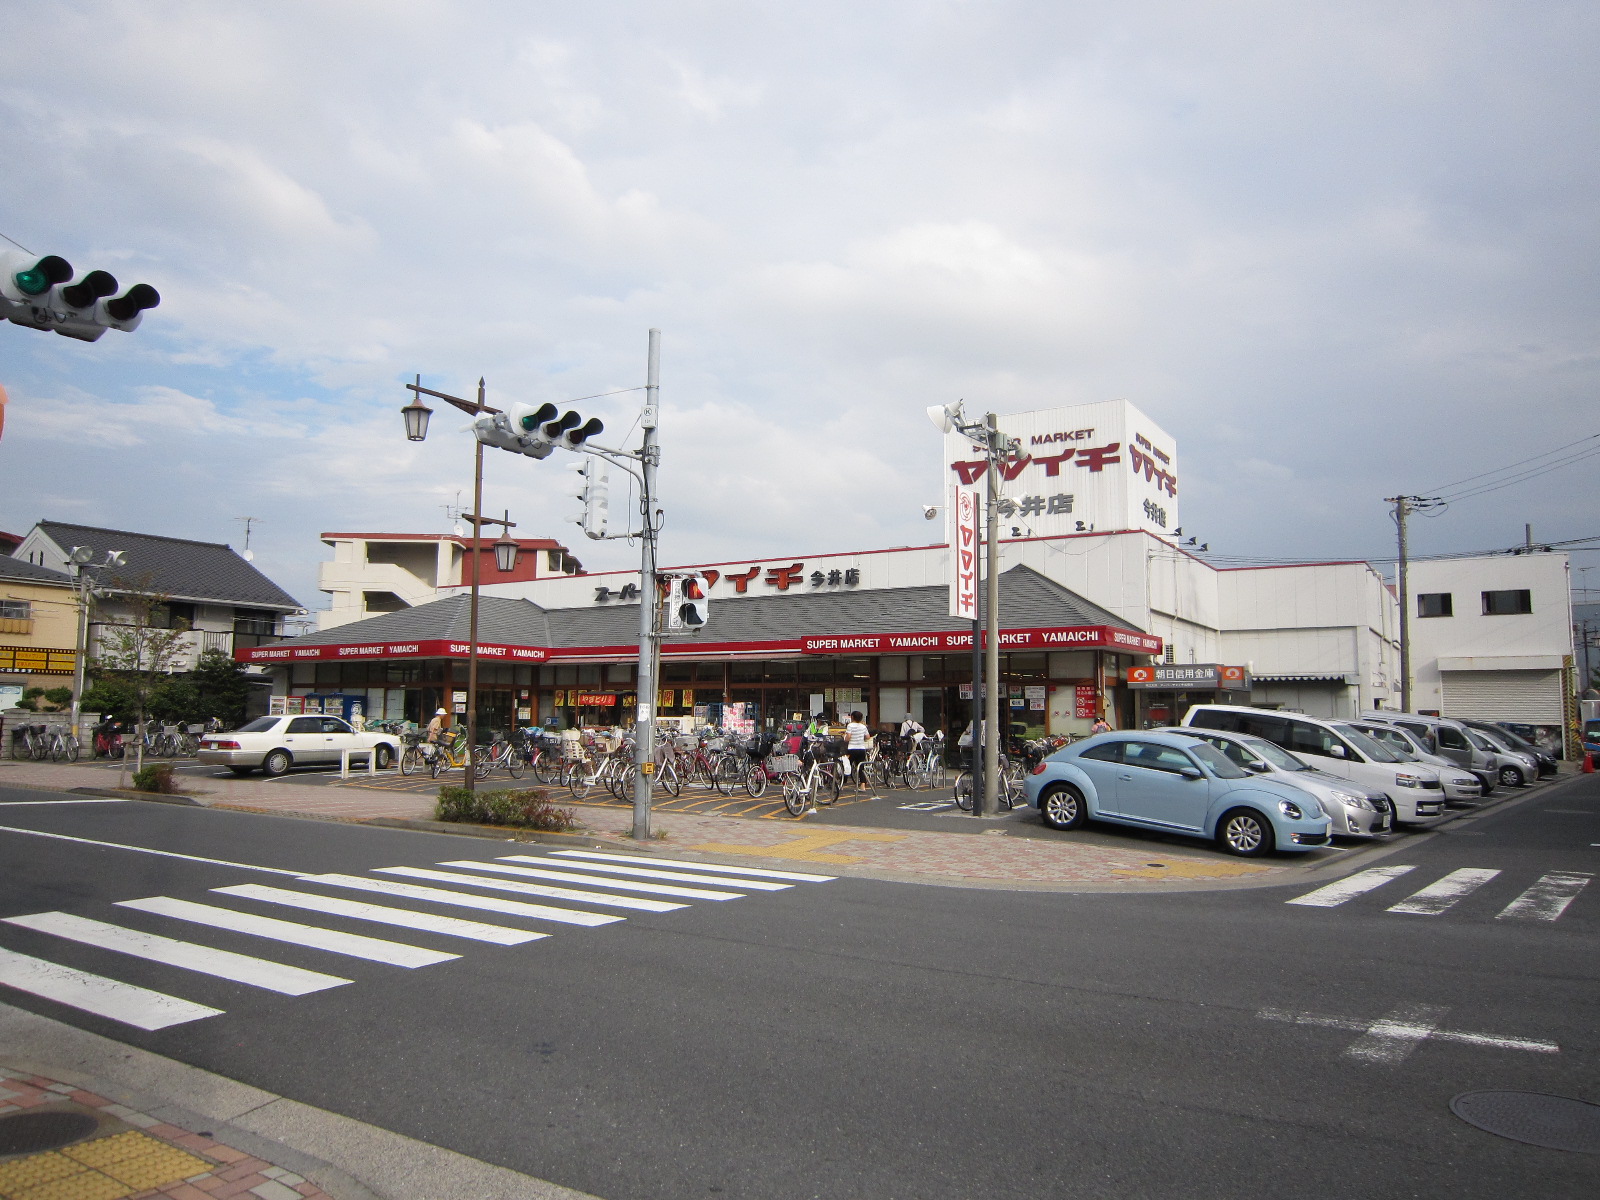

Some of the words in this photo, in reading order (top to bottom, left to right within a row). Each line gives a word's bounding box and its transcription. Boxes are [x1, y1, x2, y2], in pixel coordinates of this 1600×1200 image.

[1031, 428, 1095, 446] MARKET
[951, 443, 1120, 485] ヤマイチ
[1129, 444, 1176, 498] ヤマイチ
[1143, 498, 1166, 528] 今井店
[811, 568, 860, 587] 今井店
[959, 525, 974, 612] ヤマイチ
[807, 639, 837, 649] SUPER
[840, 638, 880, 648] MARKET
[889, 636, 938, 647] YAMAICHI
[946, 635, 973, 645] SUPE
[1042, 631, 1098, 642] YAMAICHI
[1114, 632, 1127, 644] SUPER
[1127, 635, 1140, 646] MARKET
[251, 651, 269, 659] SUPER
[269, 650, 290, 658] MARKET
[295, 649, 320, 657] YAMAICHI
[339, 647, 358, 656] SUPER
[359, 647, 384, 655] MARKET
[389, 645, 419, 653] YAMAICHI
[450, 644, 470, 653] SUPE
[477, 646, 506, 656] MARKET
[512, 649, 545, 658] YAMAICHI
[1156, 668, 1214, 679] 朝日信用金庫
